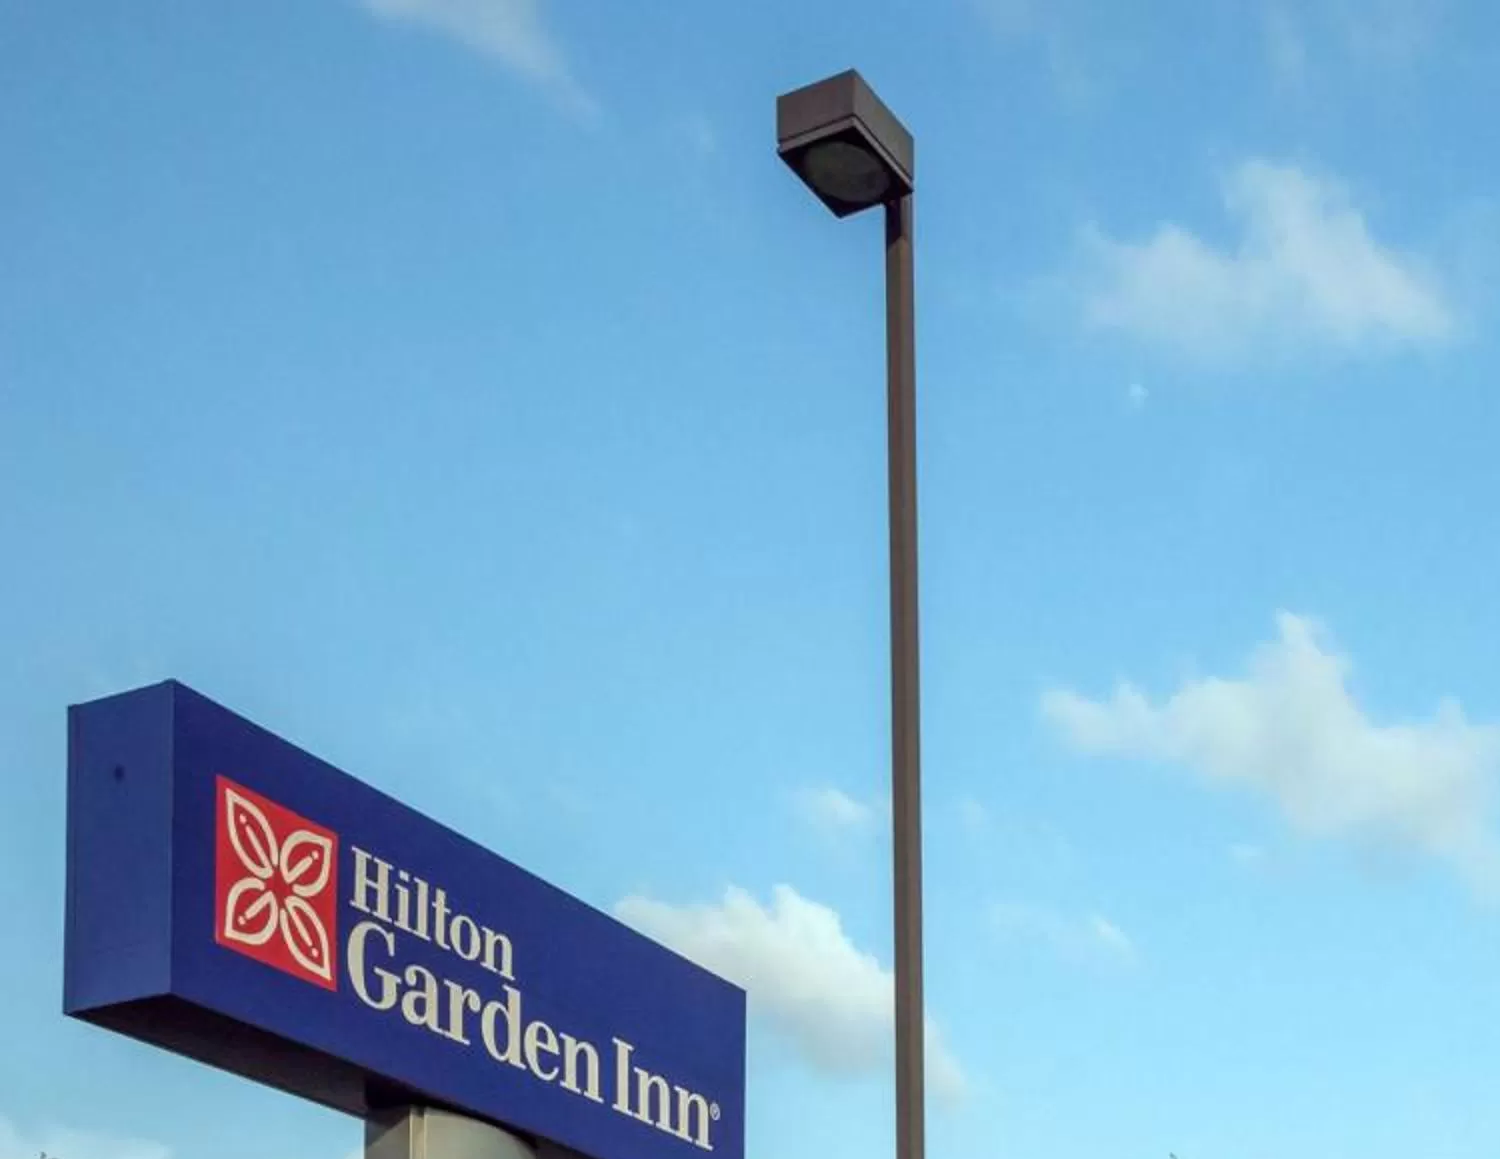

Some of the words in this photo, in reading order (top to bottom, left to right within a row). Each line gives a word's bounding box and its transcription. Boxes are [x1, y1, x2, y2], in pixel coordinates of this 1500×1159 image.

[350, 847, 515, 980] Hilton
[347, 921, 603, 1103] Garden
[612, 1037, 713, 1150] Inn
